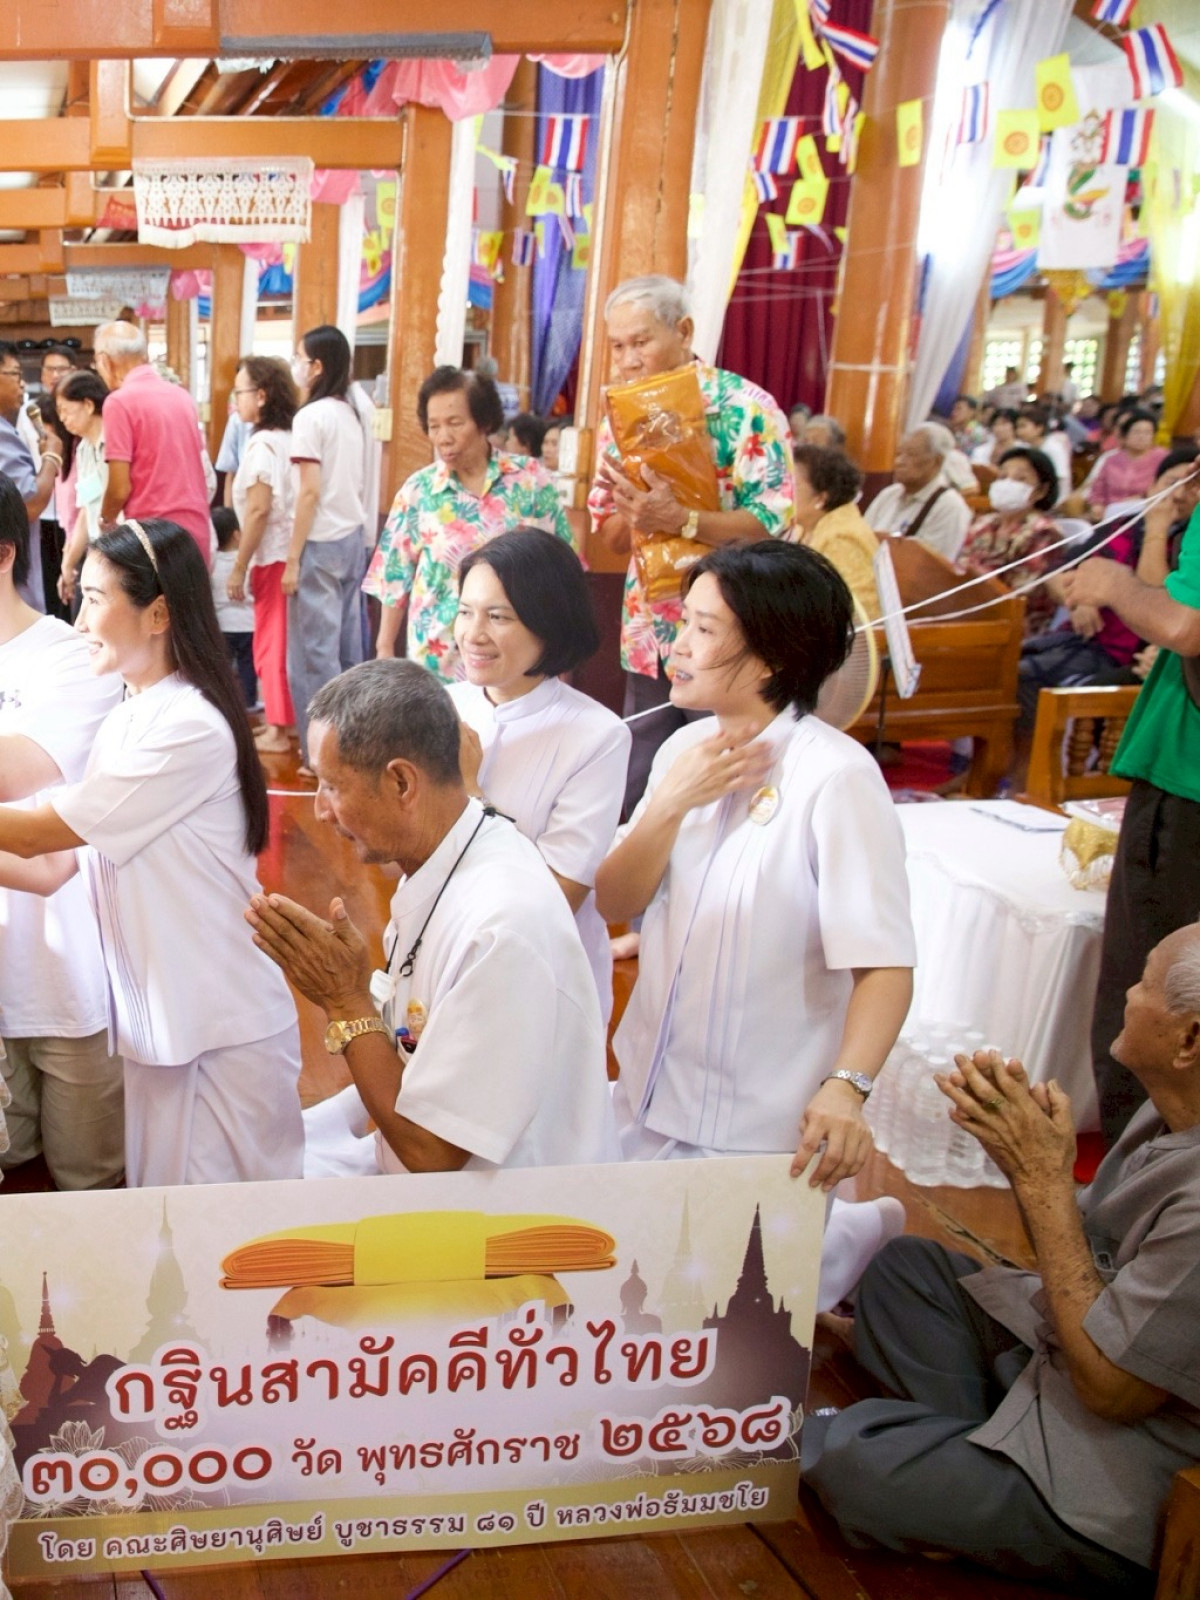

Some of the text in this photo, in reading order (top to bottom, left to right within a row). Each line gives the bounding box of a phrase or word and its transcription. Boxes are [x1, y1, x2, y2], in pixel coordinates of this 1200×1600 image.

[114, 1308, 709, 1431] กฐินสามัคคีทั่วไทย
[31, 1403, 783, 1498] ๓๐,๐๐๐ วัด พุทธศักราช ๒๕๖๘
[41, 1483, 767, 1559] โดย คณะศิษยานุศิษย์ บูชาธรรม ๘๑ ปี หลวงพ่อธัมมชโย
